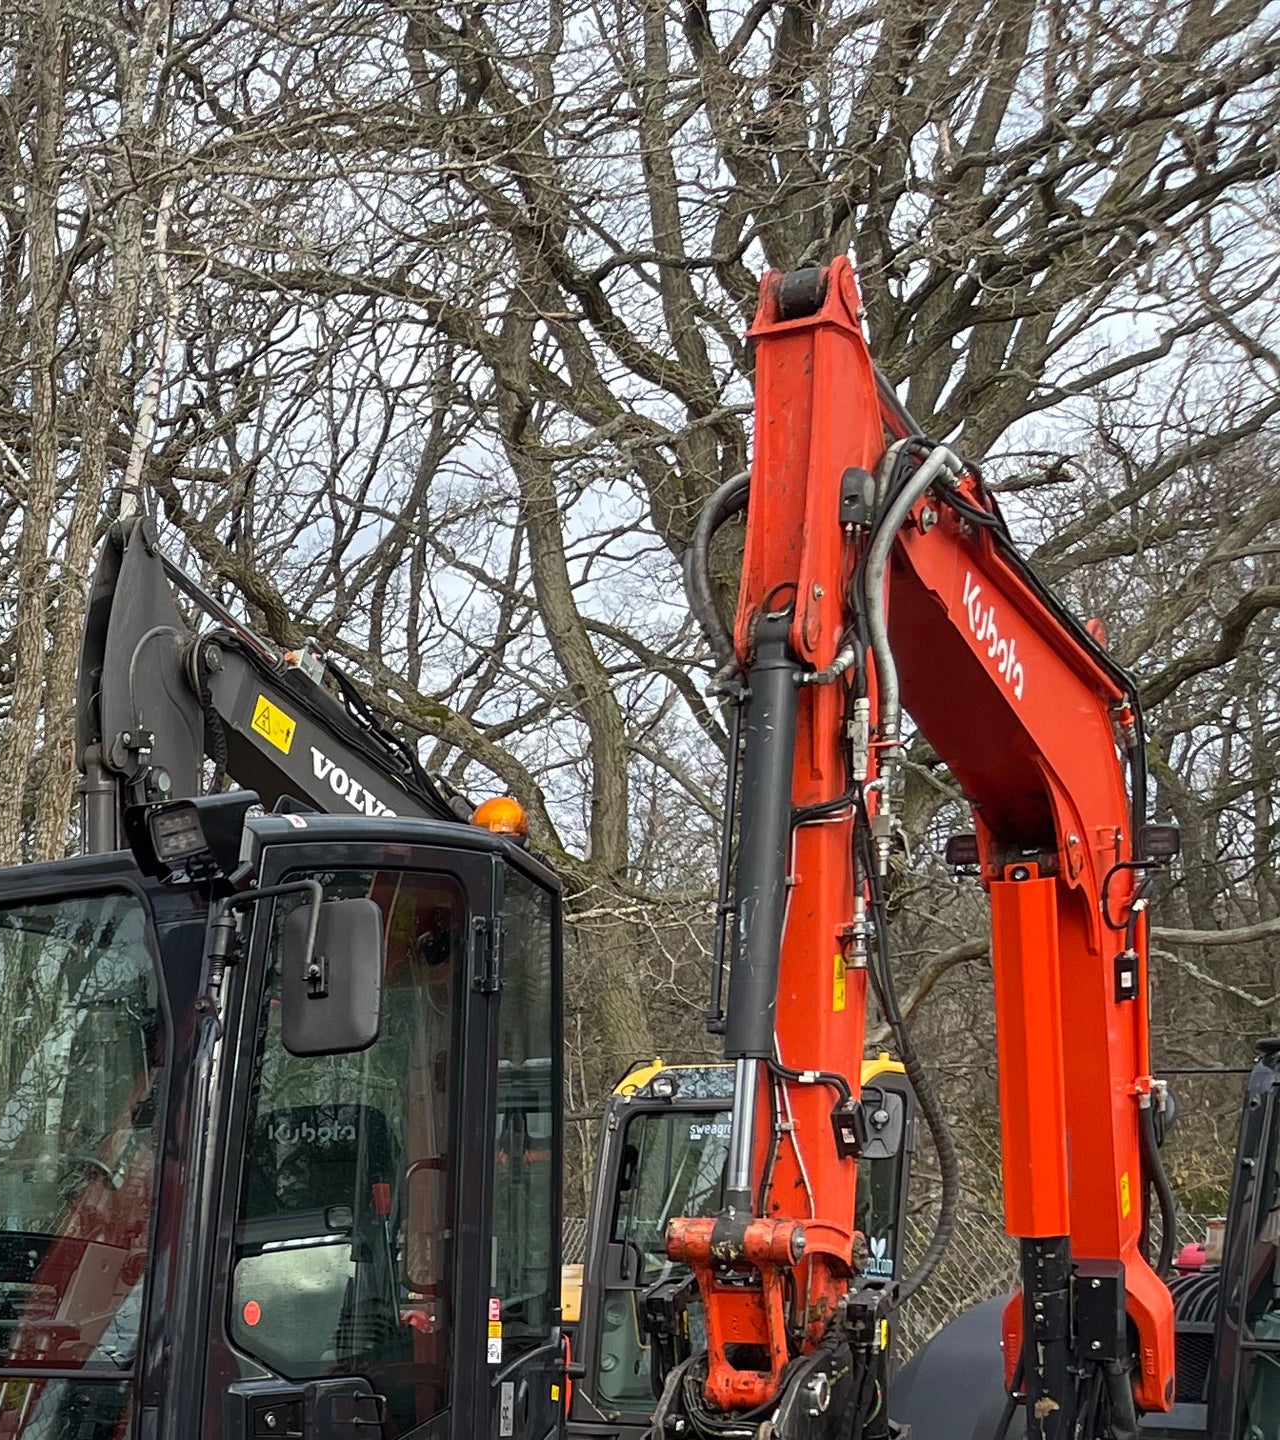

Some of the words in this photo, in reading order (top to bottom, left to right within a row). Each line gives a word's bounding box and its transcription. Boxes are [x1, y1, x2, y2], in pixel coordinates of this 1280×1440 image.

[962, 570, 1025, 701] Kubota
[310, 746, 398, 818] VOLV
[268, 1120, 356, 1145] Kubota
